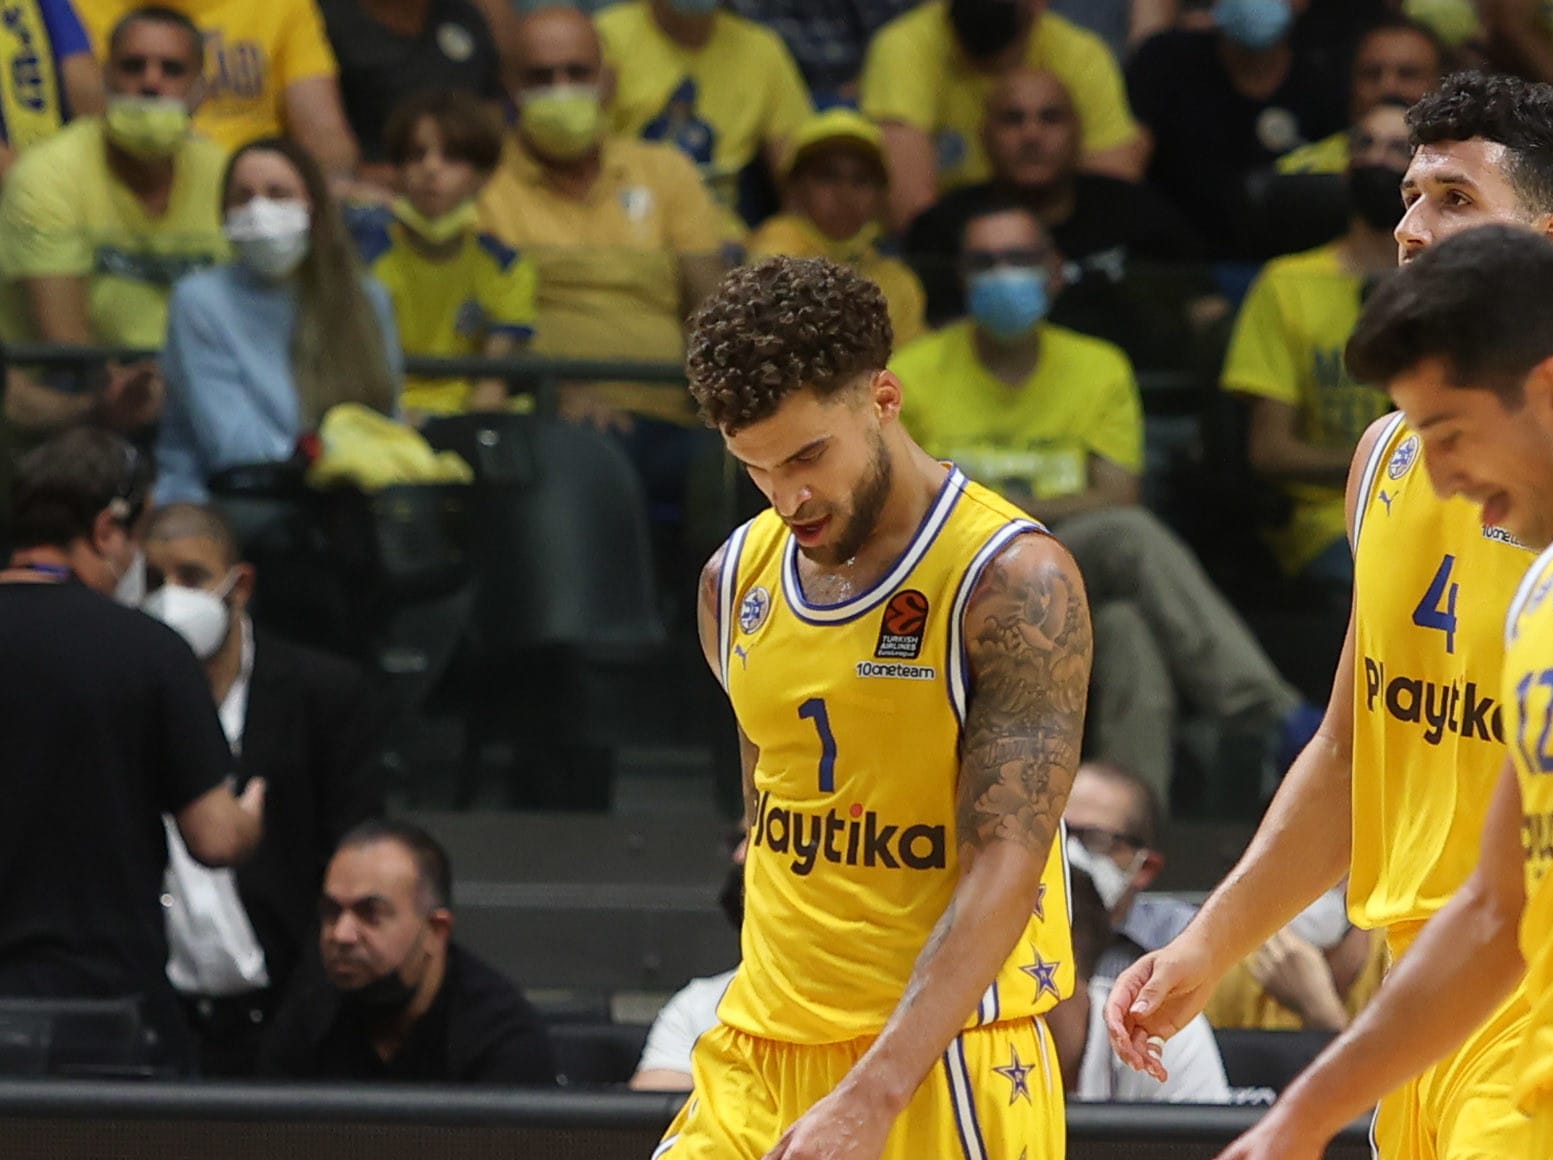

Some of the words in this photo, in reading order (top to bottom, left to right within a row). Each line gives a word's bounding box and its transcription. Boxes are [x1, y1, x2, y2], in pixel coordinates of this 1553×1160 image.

[882, 634, 919, 645] TURKISH
[1413, 554, 1457, 654] 4
[798, 698, 837, 792] 1
[752, 790, 947, 876] laytika
